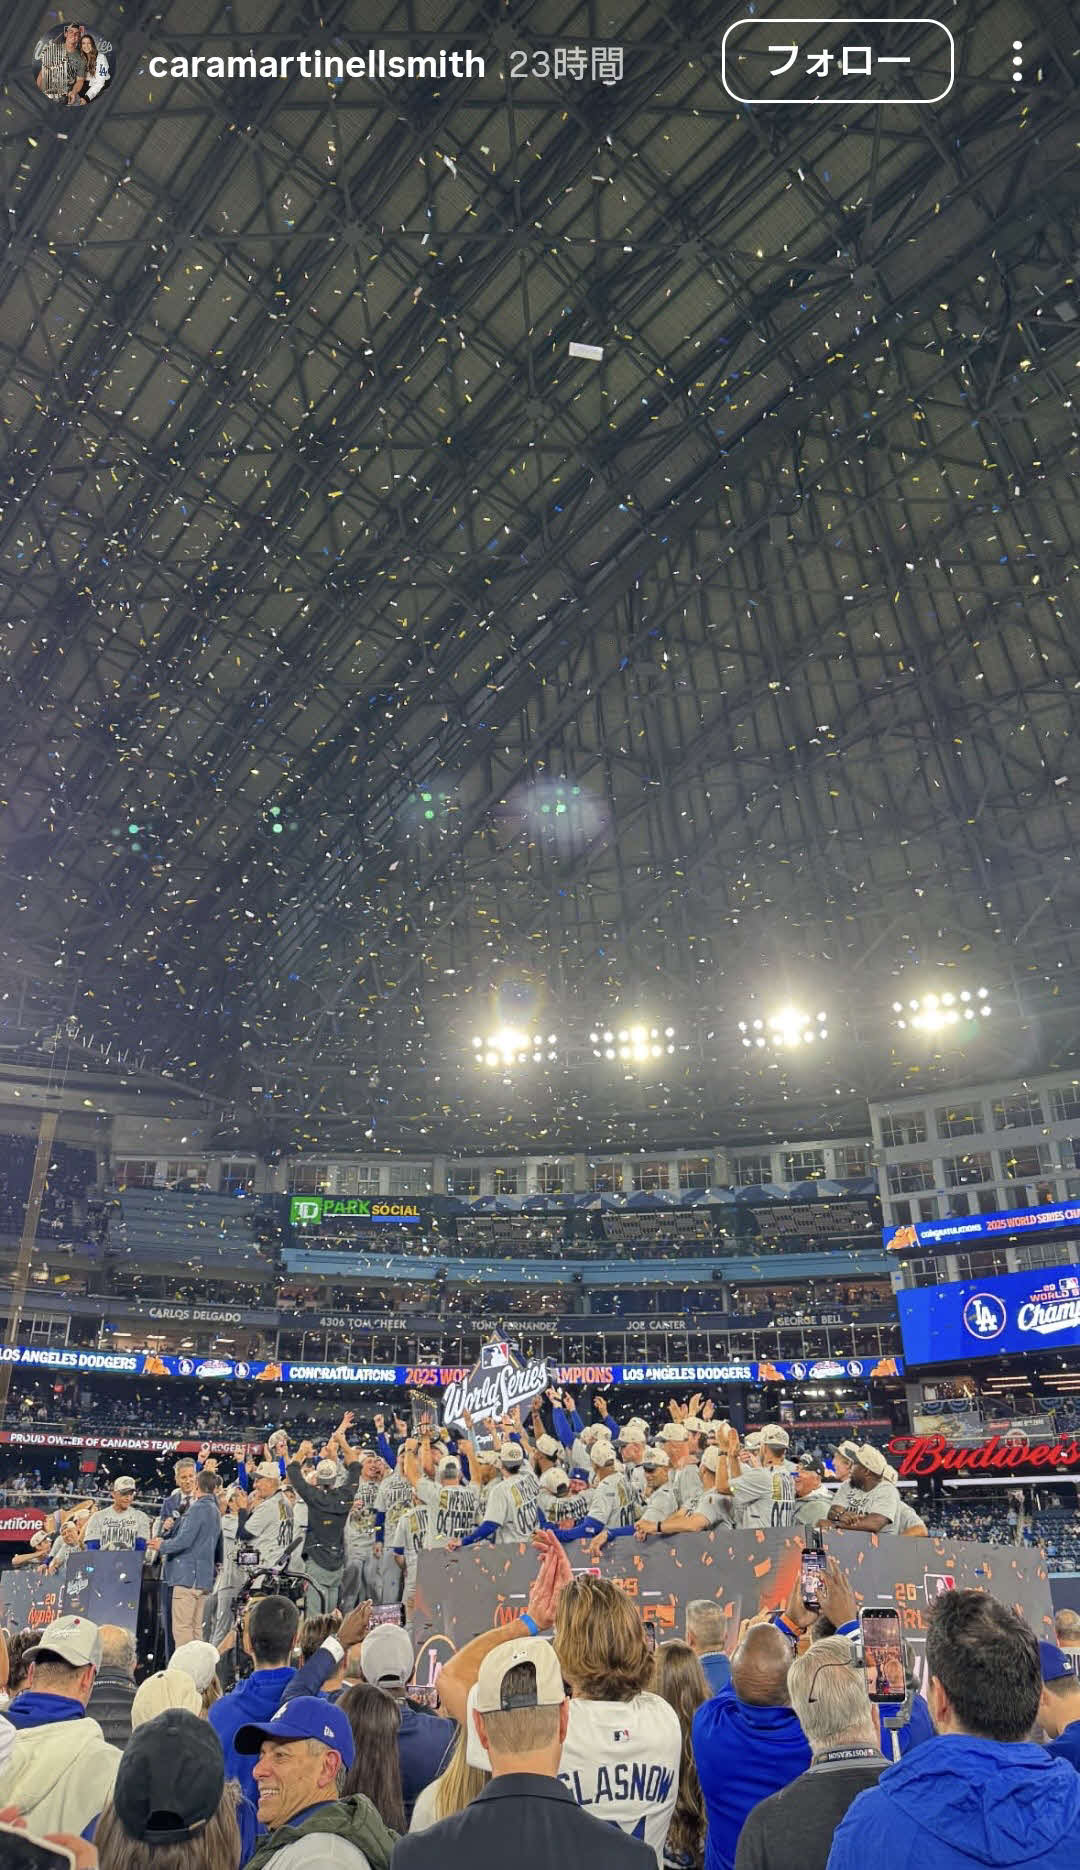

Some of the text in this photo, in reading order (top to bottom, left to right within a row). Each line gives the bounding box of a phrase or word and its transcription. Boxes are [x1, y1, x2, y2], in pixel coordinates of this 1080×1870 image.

[294, 1199, 421, 1219] TD PARK SOCIAL
[920, 1223, 982, 1238] CONGRATULATIONS
[1006, 1216, 1037, 1229] WORLD
[1037, 1210, 1066, 1224] SERIES
[1030, 1290, 1070, 1302] WORLD
[148, 1307, 242, 1323] CARLOS DELGADO
[319, 1317, 408, 1330] 4306 TOM CHEEK
[776, 1314, 845, 1327] GEORGE BELL
[972, 1299, 998, 1332] LA
[471, 1320, 558, 1331] TONY FERNANDEZ
[626, 1320, 687, 1330] JOE CARTER
[0, 1348, 137, 1370] LOS ANGELES DODGERS
[289, 1366, 397, 1383] CONGRATULATIONS
[404, 1367, 439, 1385] 2025
[622, 1365, 752, 1381] LOS ANGELES DODGERS
[443, 1361, 549, 1425] World Series
[10, 1433, 179, 1451] PROUD OWNER OF CANADA'S TEAM
[889, 1434, 1080, 1477] Budweis
[44, 1592, 57, 1606] 20
[895, 1583, 917, 1601] 20
[828, 1749, 868, 1761] POSTSEASON
